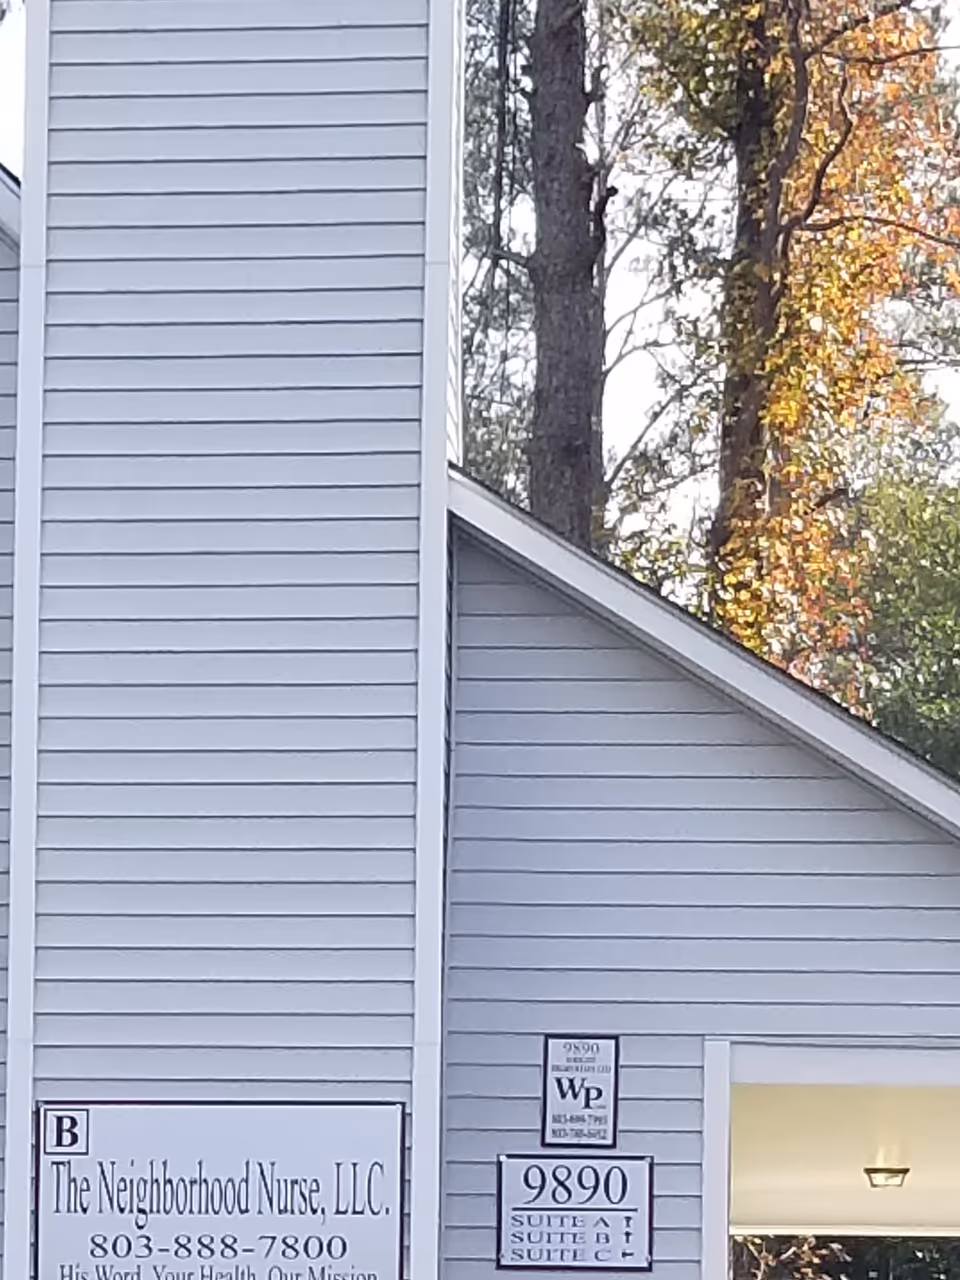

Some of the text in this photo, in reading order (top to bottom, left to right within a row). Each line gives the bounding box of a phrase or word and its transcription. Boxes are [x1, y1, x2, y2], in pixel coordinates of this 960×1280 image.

[561, 1042, 600, 1055] 9890
[553, 1076, 603, 1109] WP
[54, 1115, 79, 1148] B
[51, 1158, 390, 1230] The Neighborhood Nurse, LLC.
[522, 1164, 628, 1206] 9890
[511, 1214, 610, 1229] SUITE A
[89, 1234, 348, 1261] 803-888-7800
[510, 1231, 610, 1245] SUITE B
[510, 1247, 611, 1262] SUITE C
